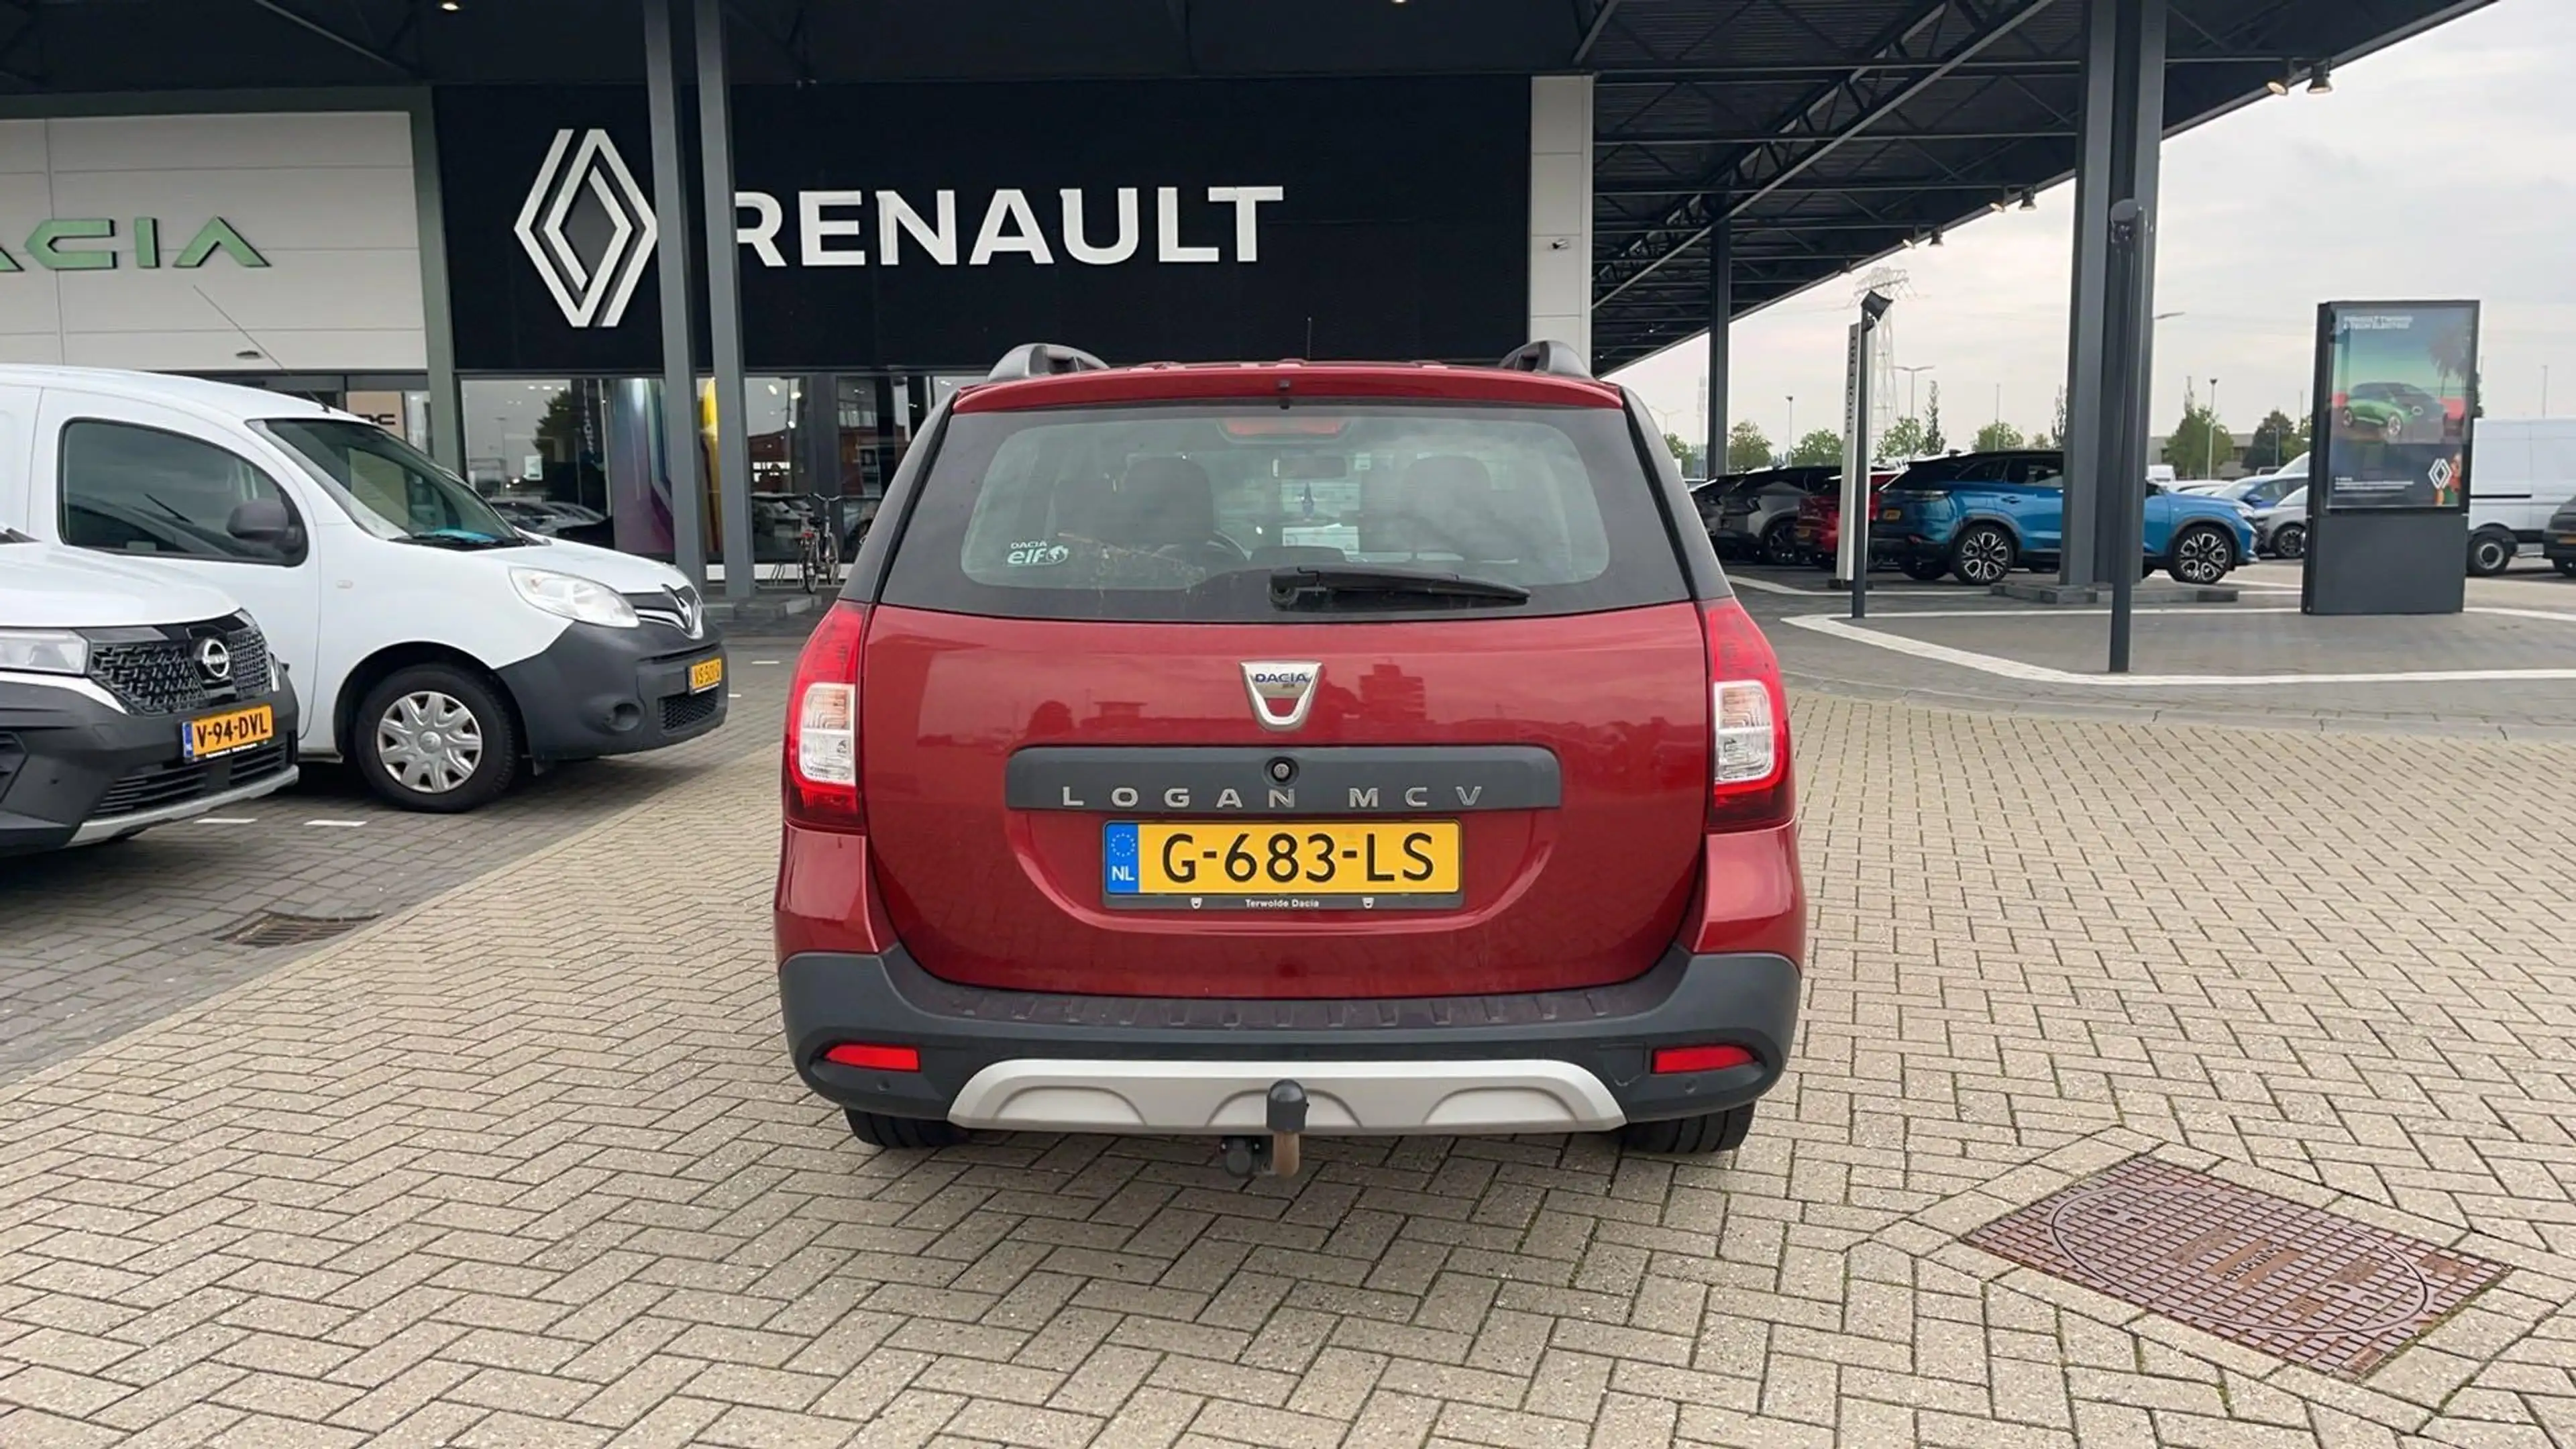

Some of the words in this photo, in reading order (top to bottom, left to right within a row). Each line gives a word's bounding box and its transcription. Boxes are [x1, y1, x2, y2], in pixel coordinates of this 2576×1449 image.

[735, 186, 1284, 267] RENAULT
[0, 215, 272, 272] CIA
[1010, 541, 1047, 549] DACIA
[1008, 548, 1046, 564] elf
[1255, 673, 1307, 682] DACIA
[196, 712, 268, 748] V-94-DVL
[1062, 786, 1295, 808] LOGAN
[1348, 786, 1483, 808] MCV
[1161, 831, 1434, 884] G-683-LS
[1111, 865, 1135, 881] NL
[1245, 898, 1289, 908] Terwolde
[1291, 898, 1320, 908] Dacia
